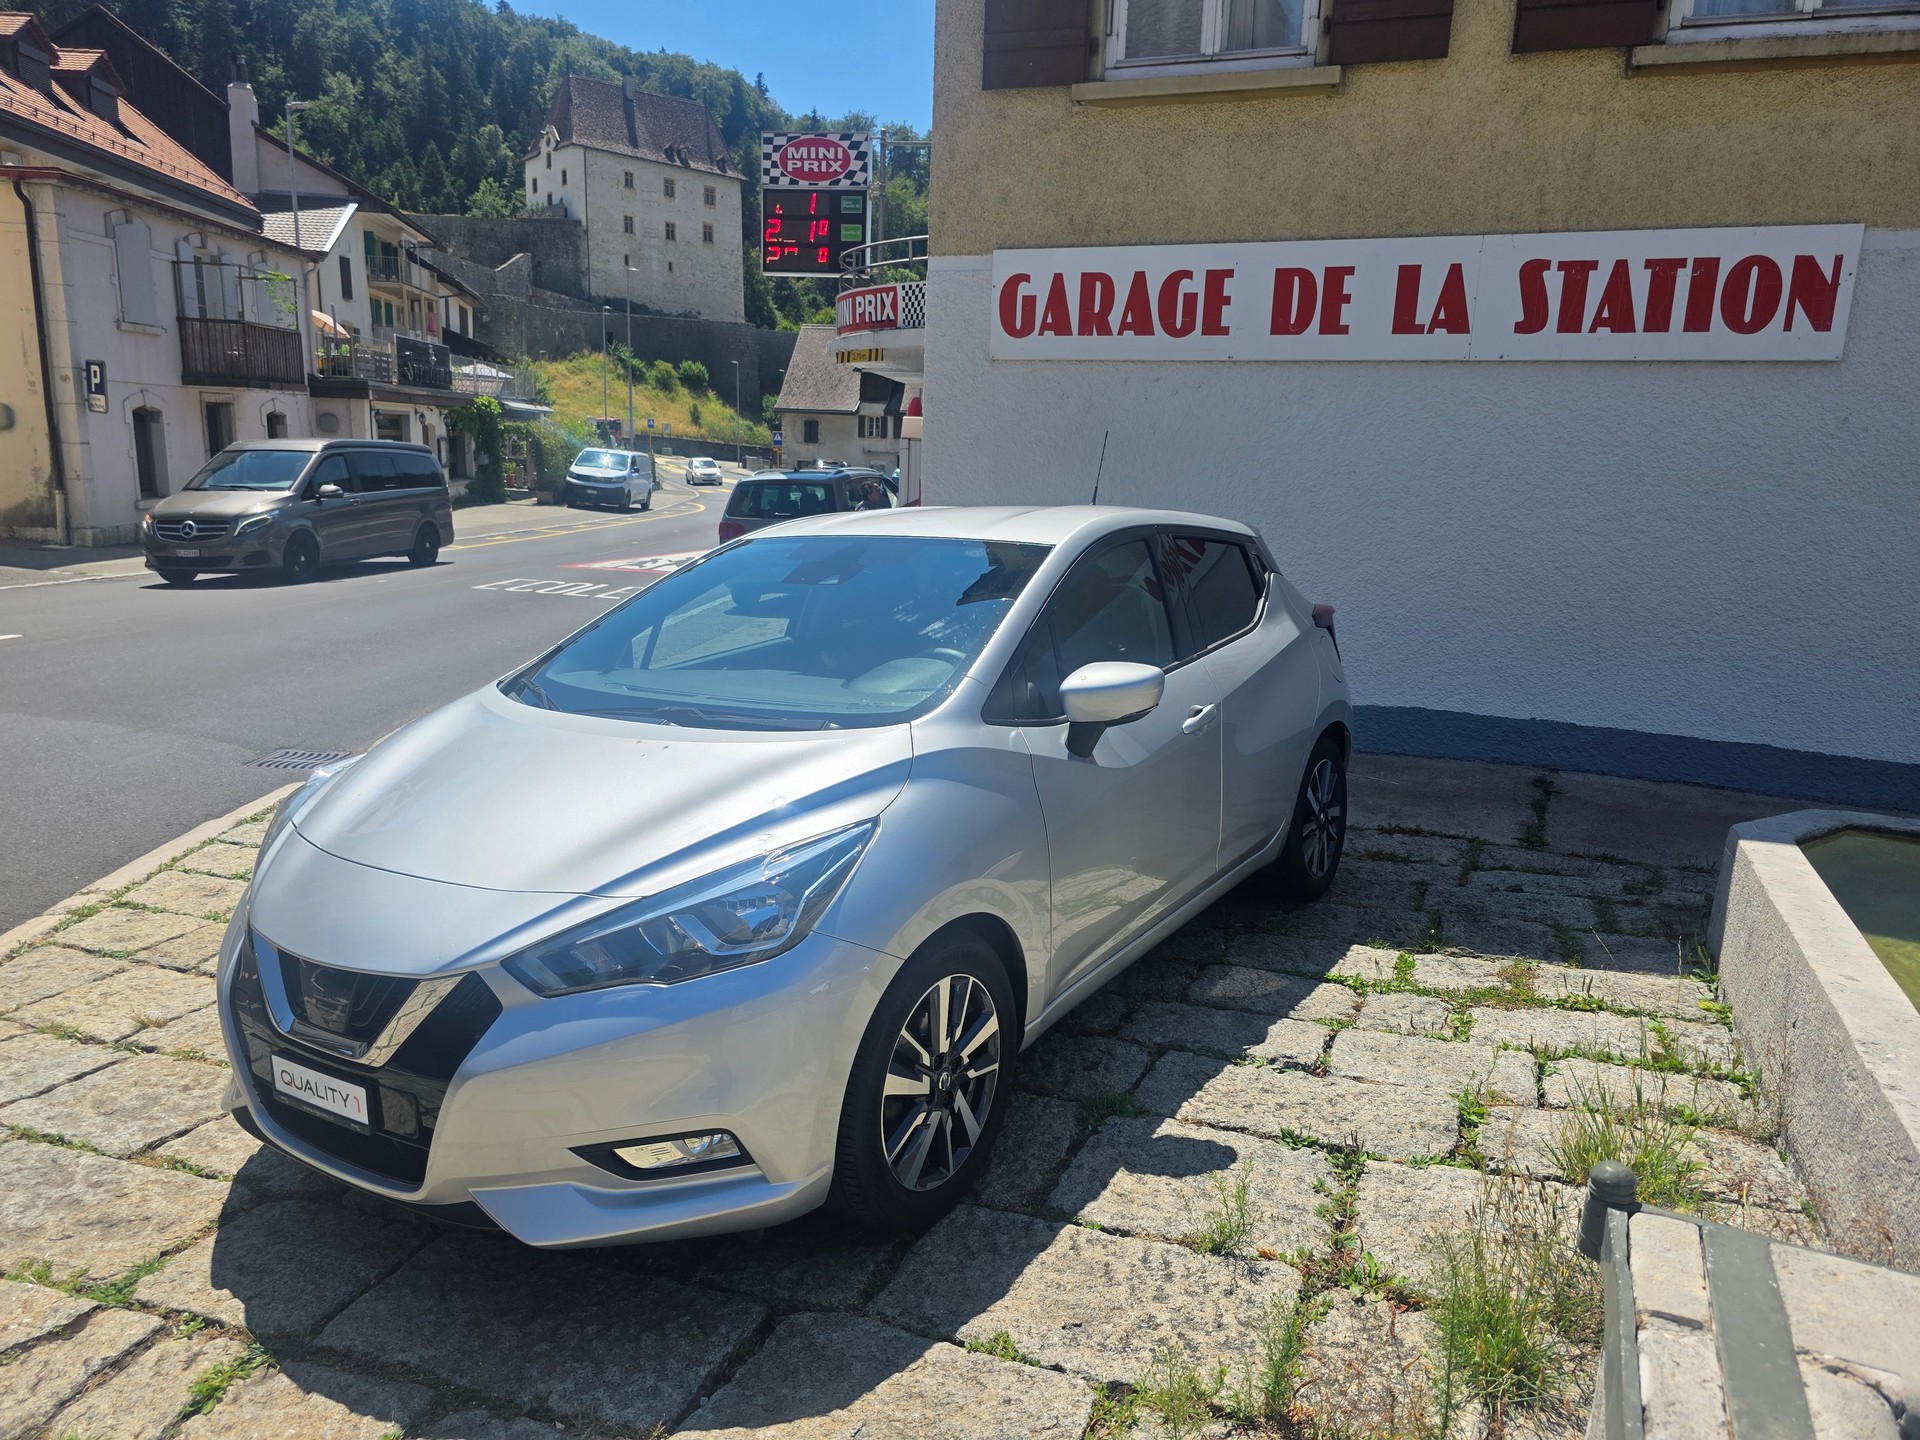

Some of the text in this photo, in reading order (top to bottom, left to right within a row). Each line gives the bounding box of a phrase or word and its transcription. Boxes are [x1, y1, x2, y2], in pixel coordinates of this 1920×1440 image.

[787, 146, 844, 160] MINI
[787, 160, 844, 174] PRIX
[856, 292, 895, 324] PRIX
[999, 254, 1843, 339] GARAGE DE LA STATION
[90, 364, 101, 392] P
[471, 578, 643, 600] ECOLE
[280, 1069, 350, 1109] QUALITY
[353, 1095, 361, 1114] 1
